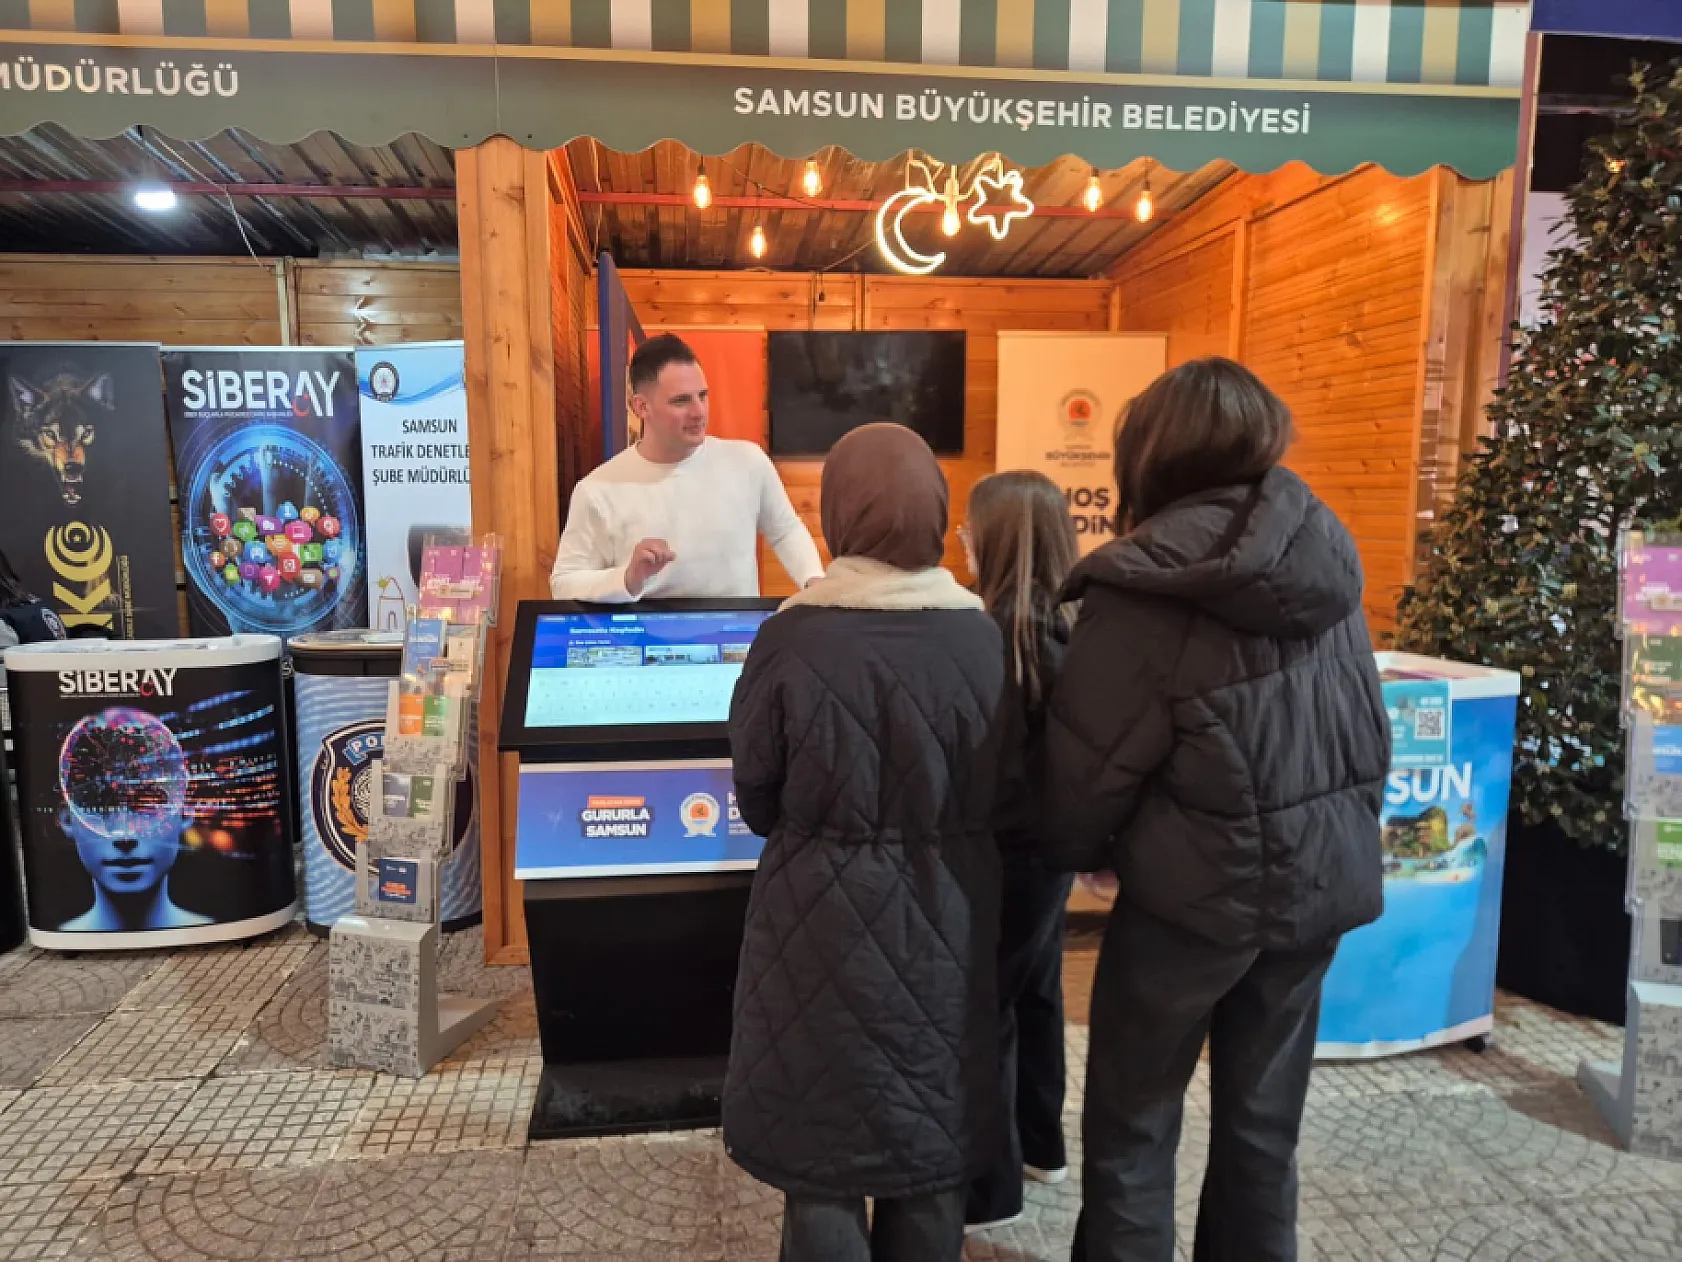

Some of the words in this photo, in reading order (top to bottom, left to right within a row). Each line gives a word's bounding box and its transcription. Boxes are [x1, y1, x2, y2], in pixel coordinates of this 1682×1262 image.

[734, 87, 884, 119] SAMSUN
[895, 93, 1112, 130] BÜYÜKŞEHİR
[1122, 100, 1311, 134] BELEDİYESİ
[402, 419, 458, 433] SAMSUN
[370, 442, 415, 459] TRAFİK
[372, 470, 404, 486] ŞUBE
[581, 808, 651, 822] GURURLA
[586, 823, 647, 837] SAMSUN
